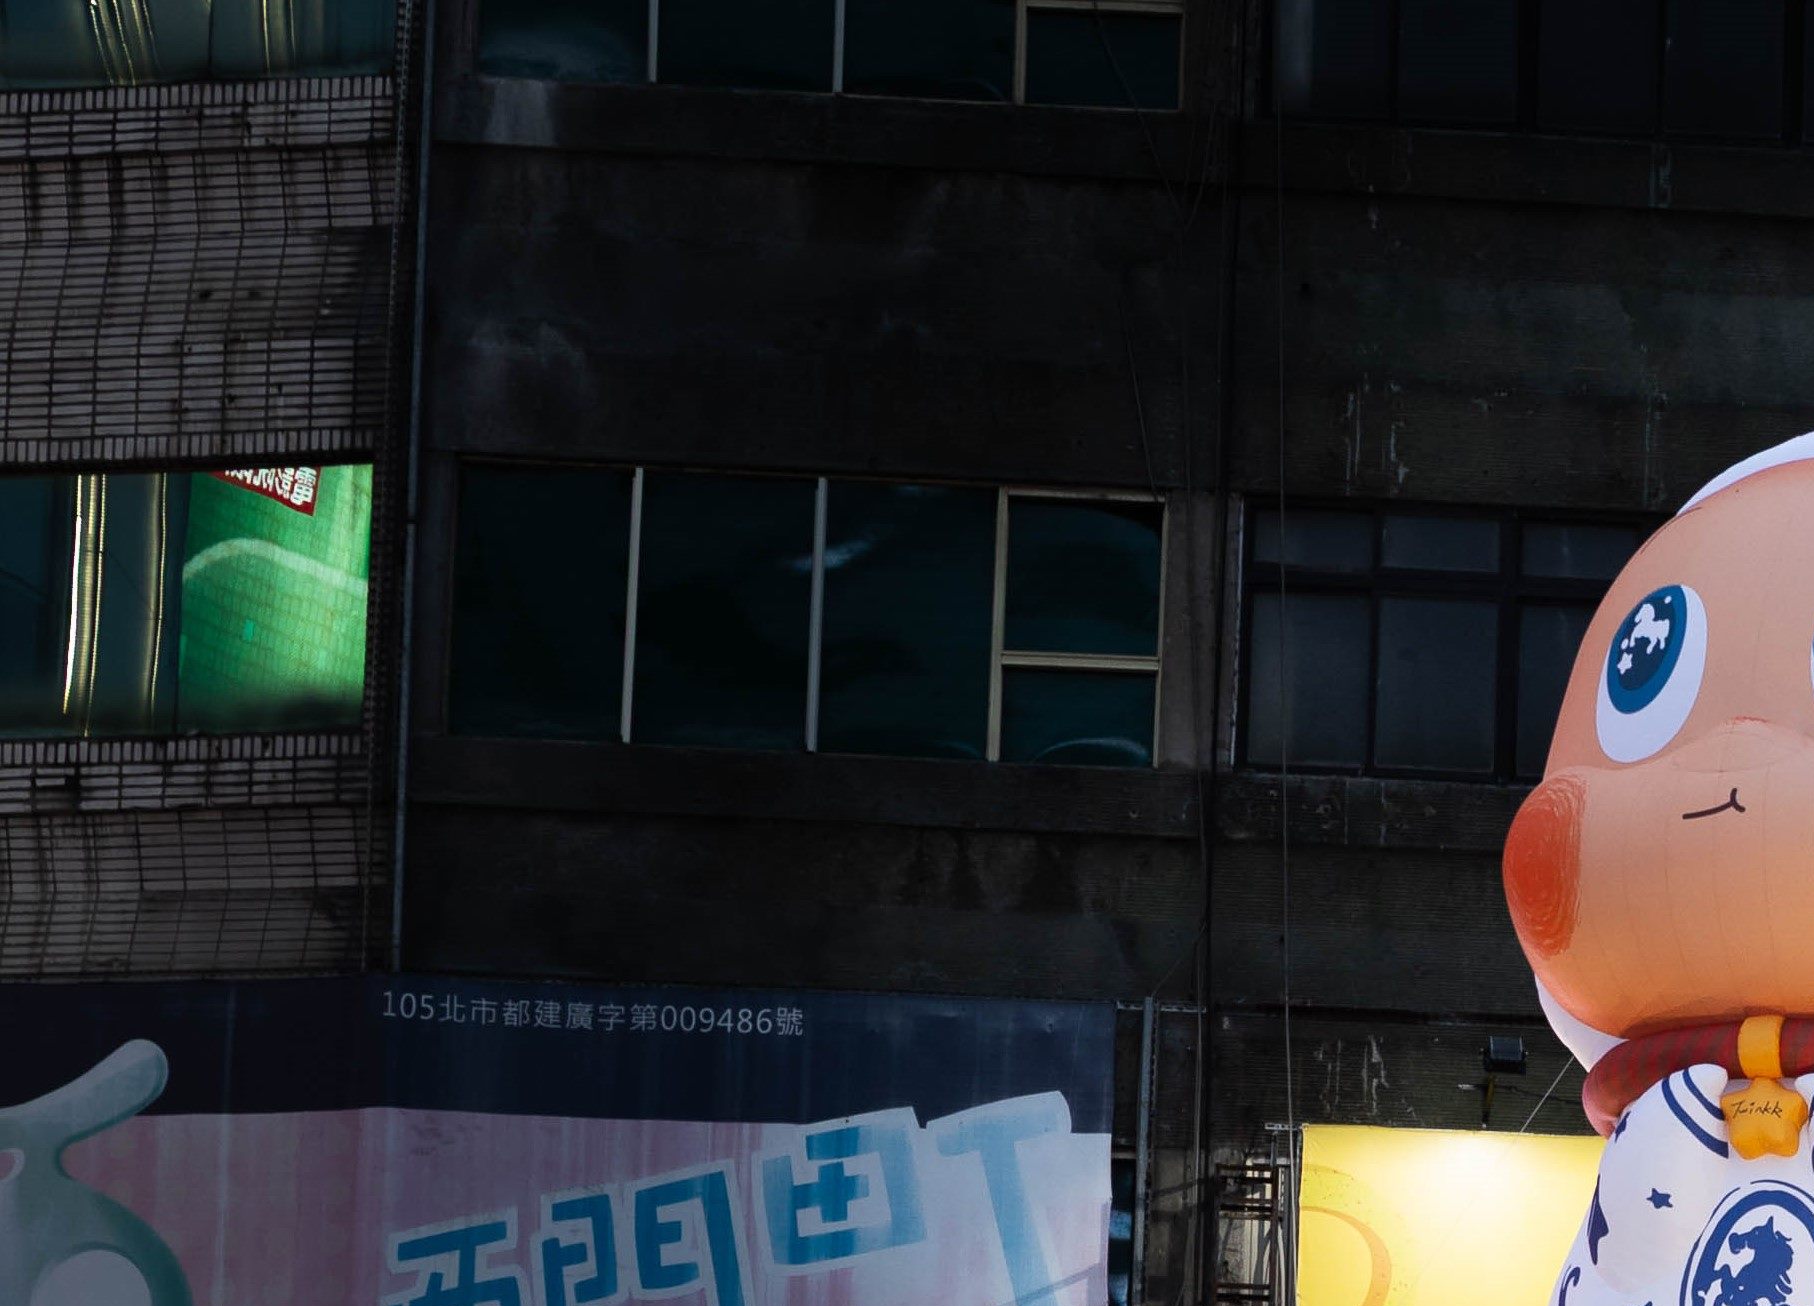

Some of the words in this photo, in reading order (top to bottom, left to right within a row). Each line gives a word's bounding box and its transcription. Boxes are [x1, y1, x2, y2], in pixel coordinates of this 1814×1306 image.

[381, 990, 804, 1037] 105北市都建廣字第009486號
